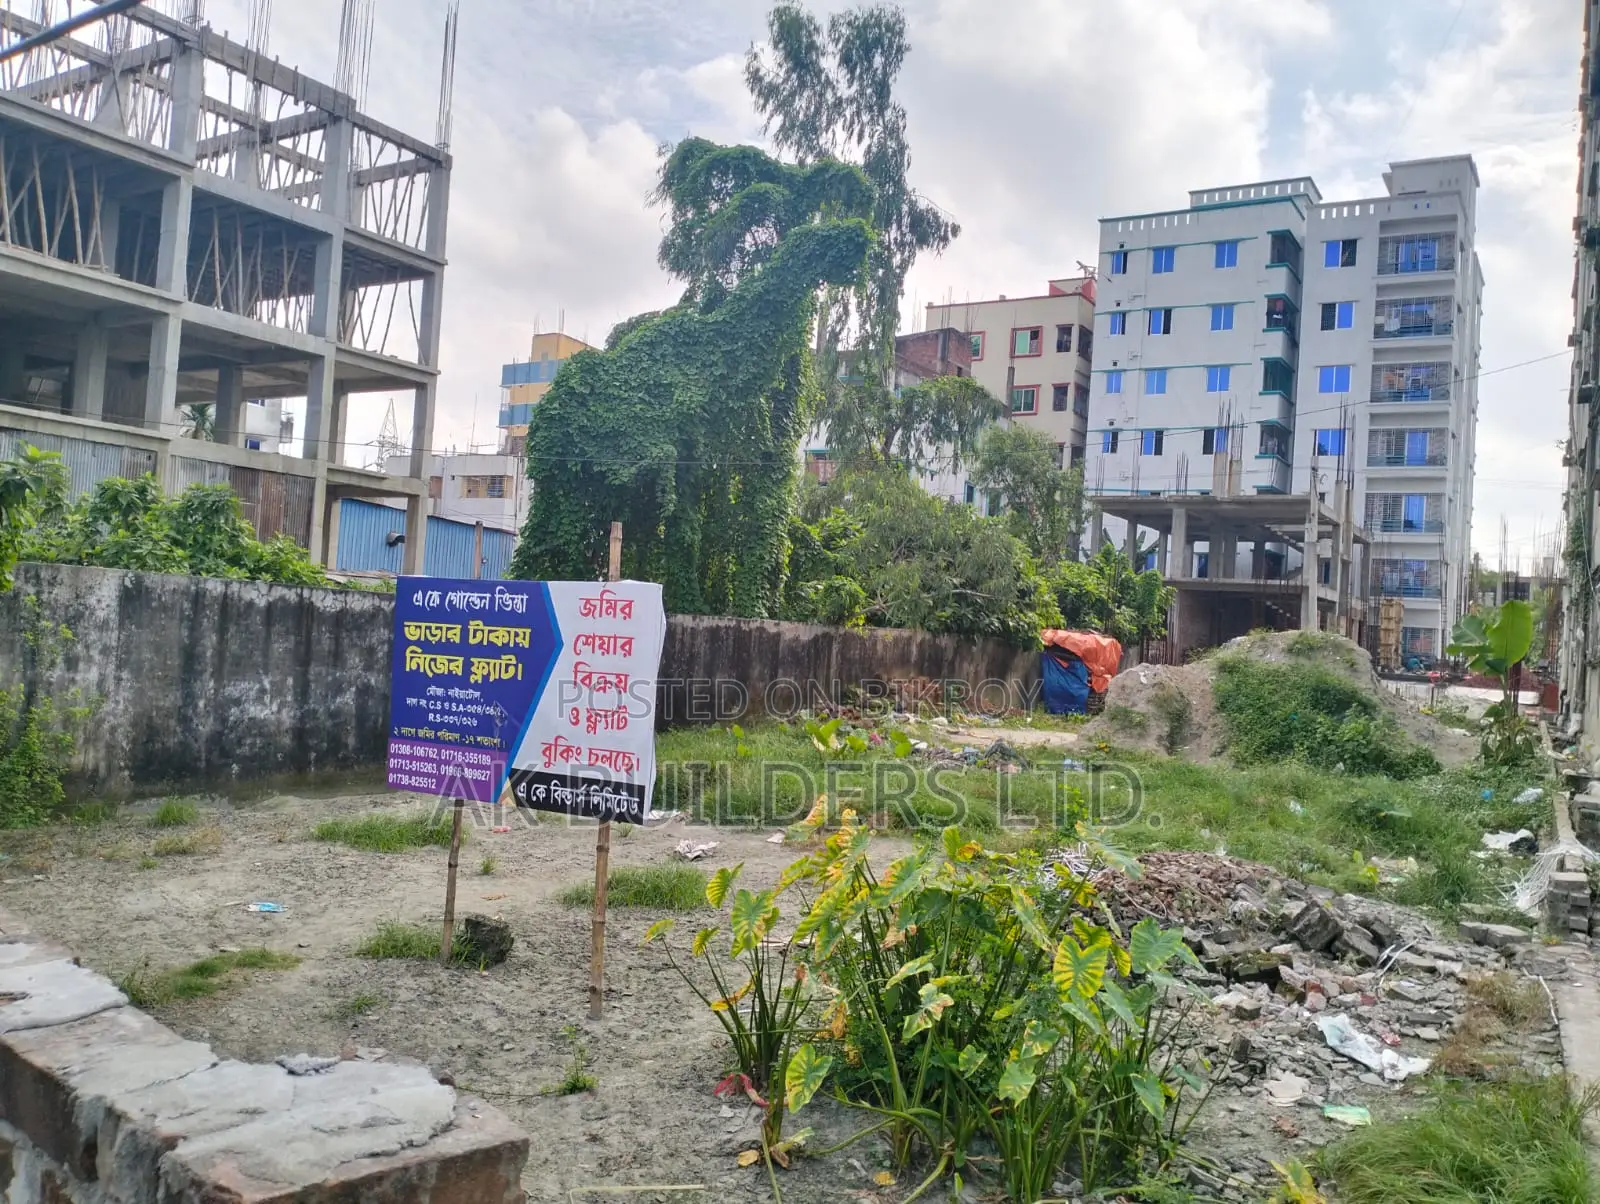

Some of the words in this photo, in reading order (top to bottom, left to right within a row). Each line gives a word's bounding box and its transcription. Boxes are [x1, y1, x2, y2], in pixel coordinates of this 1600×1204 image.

[445, 589, 491, 612] গোল্ডেন
[578, 588, 635, 620] জমির
[403, 621, 462, 645] ভাড়ার
[468, 620, 531, 648] টাকায়
[573, 632, 635, 657] শেয়ার
[405, 645, 464, 678] নিজের
[572, 661, 630, 694] বিক্রয়
[428, 700, 442, 710] C.S
[569, 706, 580, 726] ও
[586, 705, 629, 735] ফ্ল্যাট
[440, 749, 491, 766] 01716-355189
[540, 735, 582, 769] বুকিং
[388, 772, 436, 789] 01738-825512
[516, 782, 527, 799] এ
[530, 783, 548, 803] কে
[550, 779, 588, 808] বিল্ডার্স
[590, 784, 640, 815] লিমিটেড
